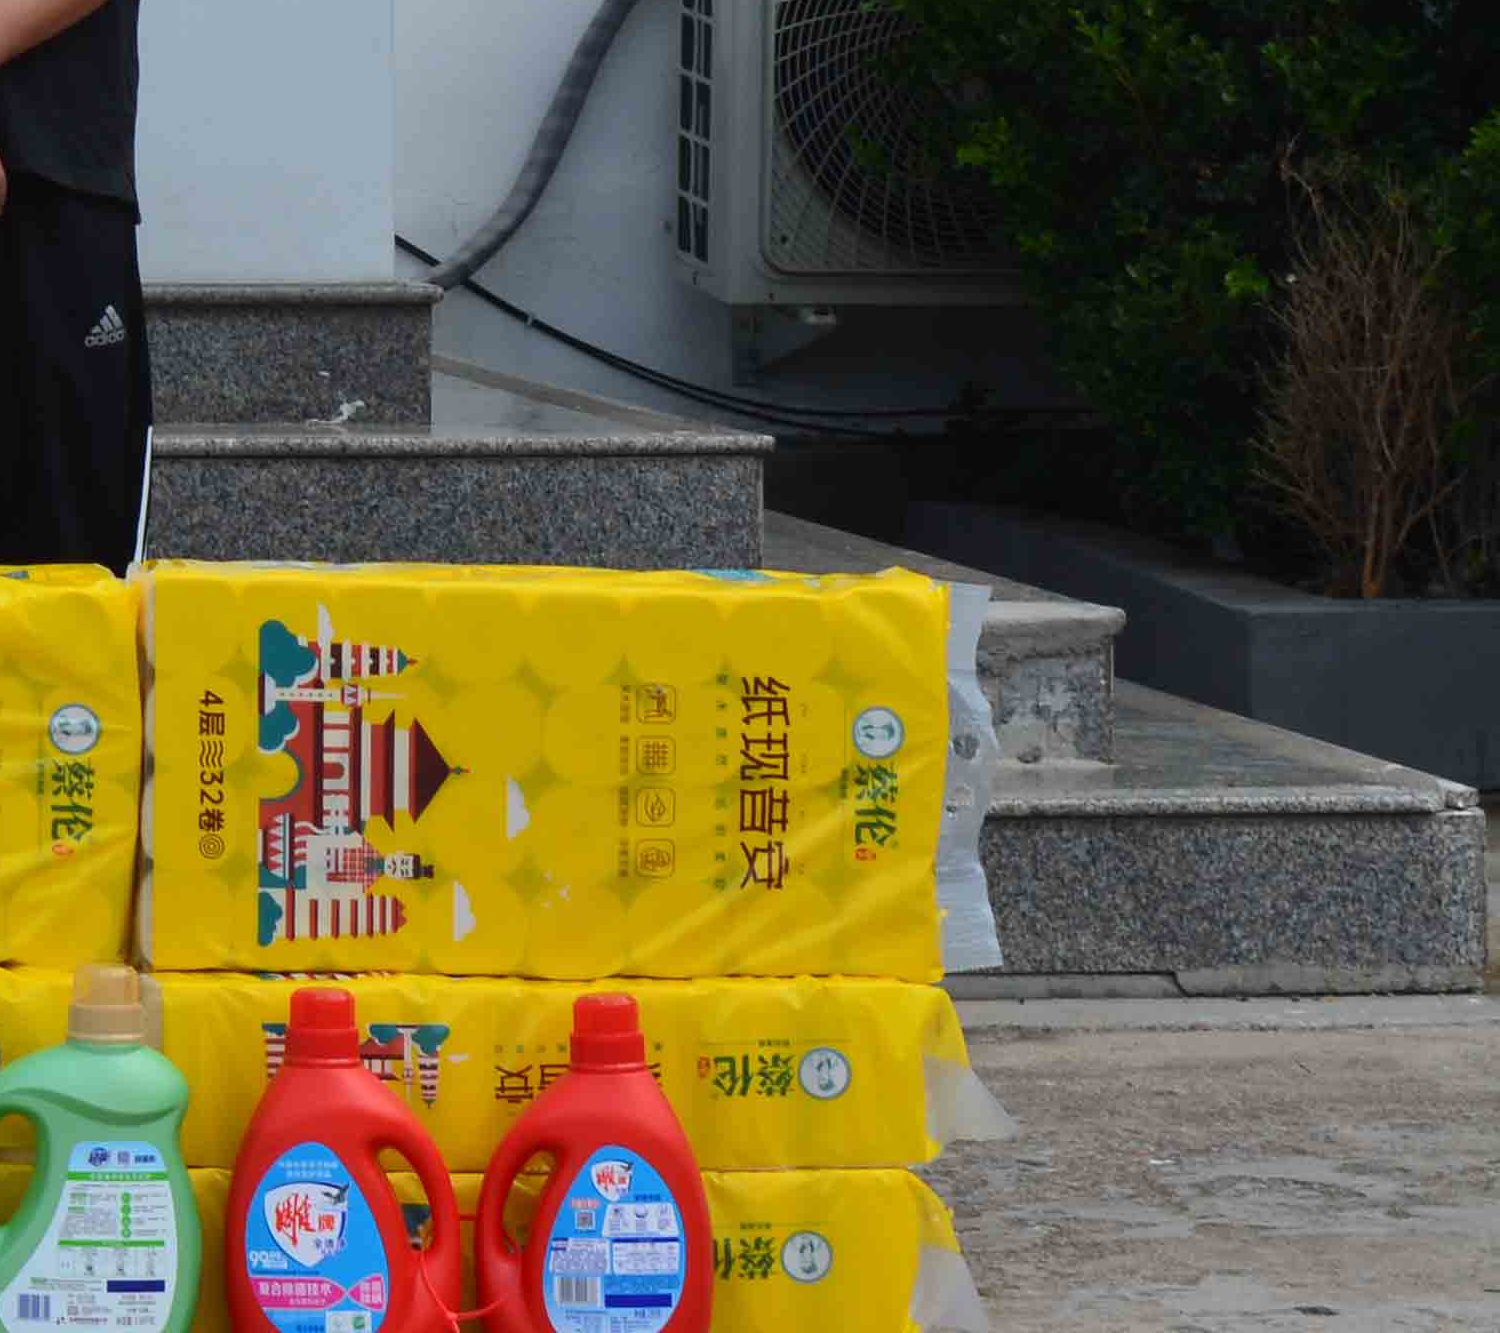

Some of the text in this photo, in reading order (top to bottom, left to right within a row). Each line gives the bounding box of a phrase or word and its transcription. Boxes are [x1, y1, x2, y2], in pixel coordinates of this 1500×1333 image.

[52, 760, 94, 841] 蔡伦
[200, 690, 224, 833] 4层 32卷
[854, 764, 898, 847] 蔡伦
